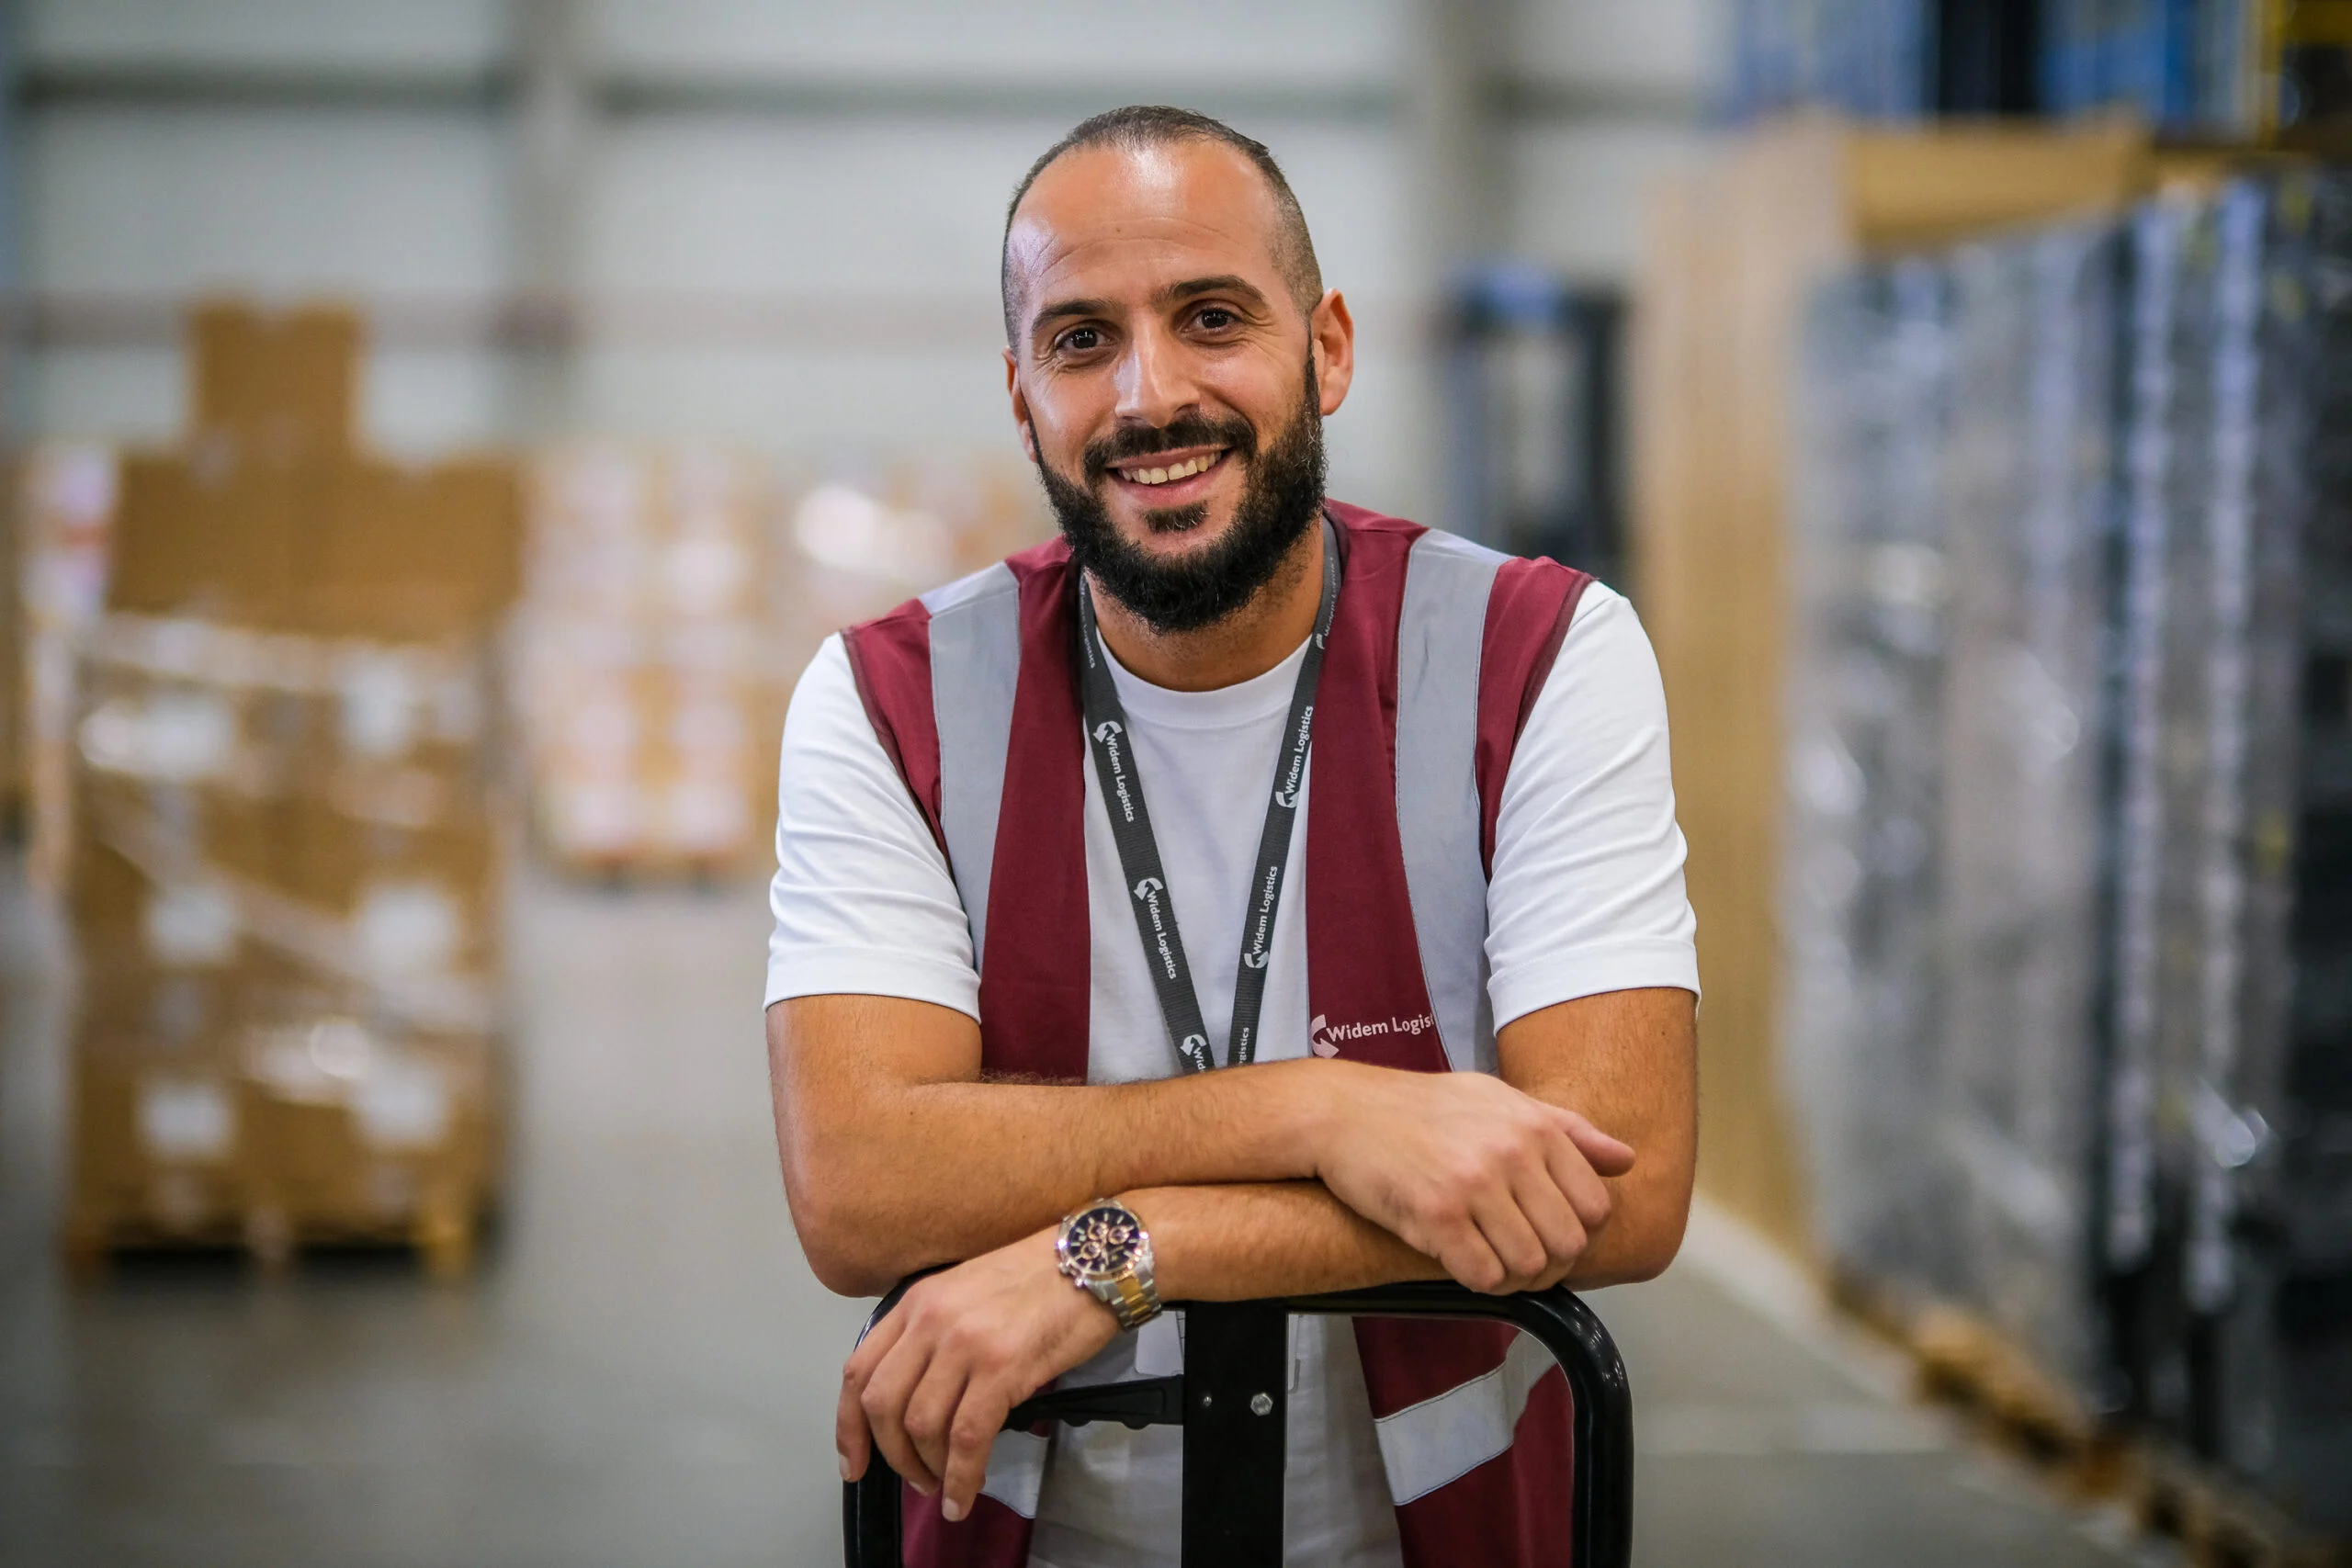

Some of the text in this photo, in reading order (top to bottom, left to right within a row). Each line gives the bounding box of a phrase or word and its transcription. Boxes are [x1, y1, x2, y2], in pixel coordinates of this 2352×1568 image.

[1106, 732, 1135, 823] Widem Logistics
[1284, 705, 1314, 795] Widem Logistics
[1147, 890, 1177, 980] Widem Logistics
[1253, 866, 1278, 955] Widem Logistics
[1326, 1021, 1388, 1043] Widem
